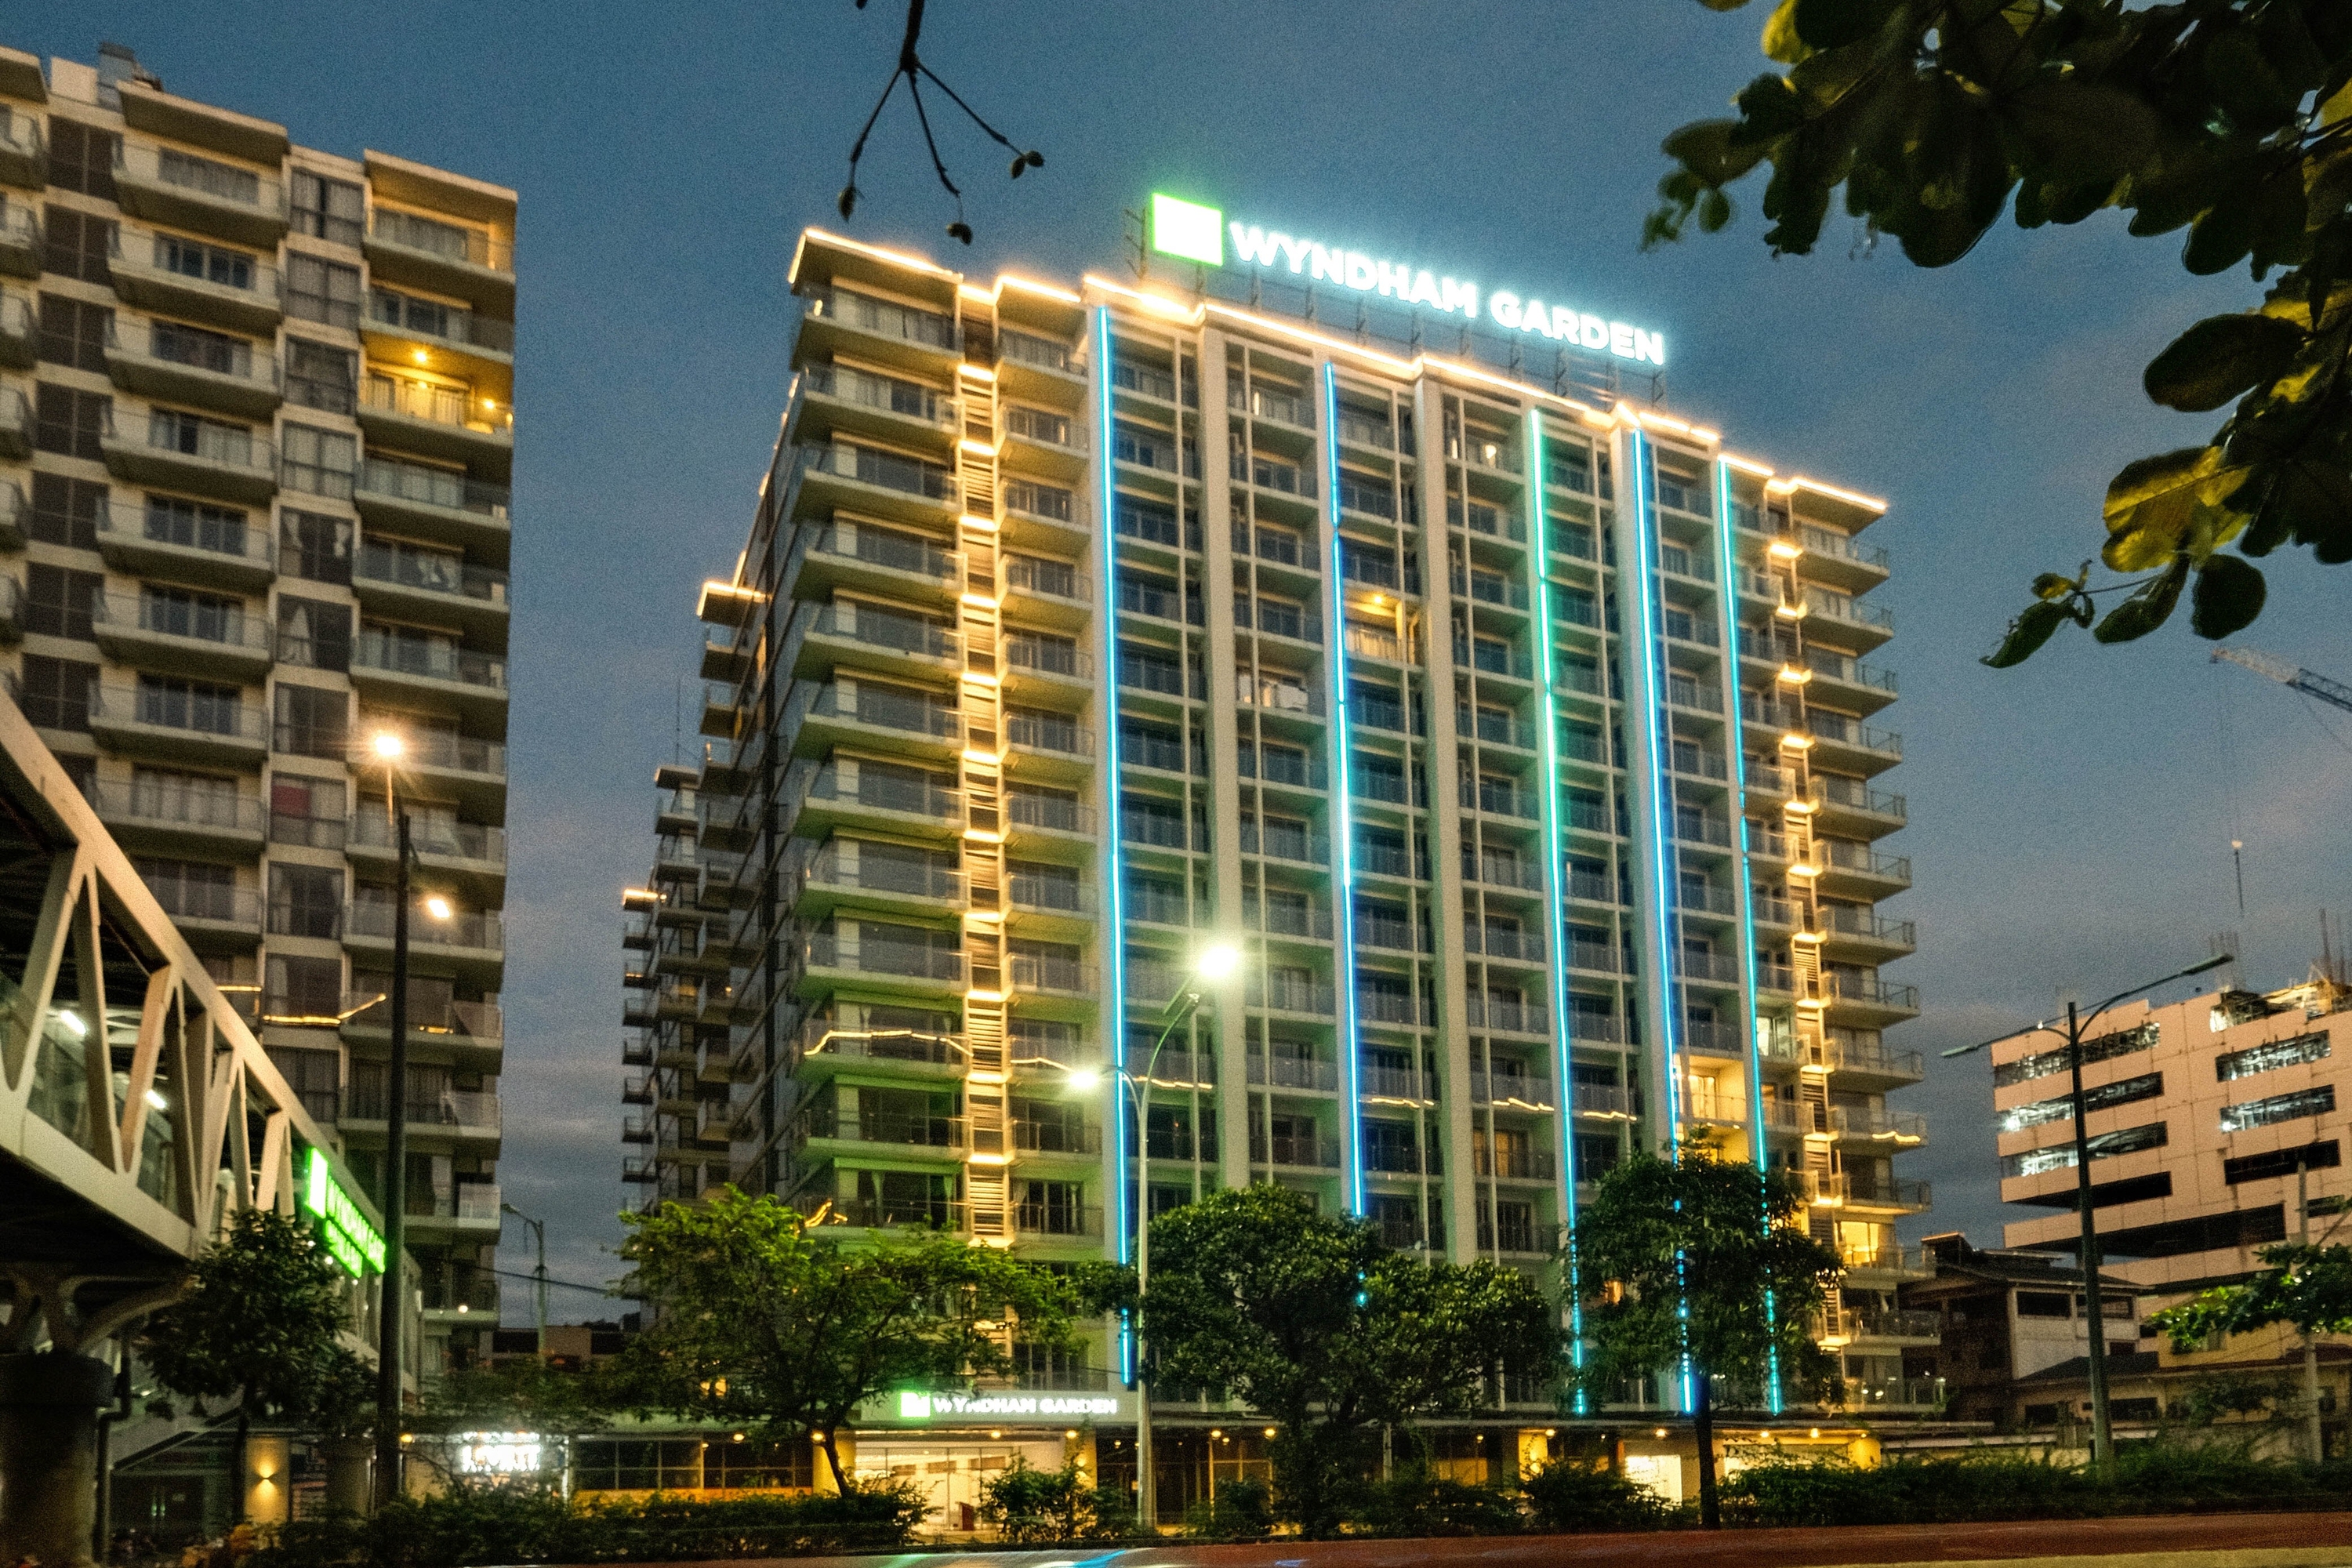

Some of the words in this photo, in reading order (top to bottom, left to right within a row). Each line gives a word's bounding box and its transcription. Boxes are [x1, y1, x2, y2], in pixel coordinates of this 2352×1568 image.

[1229, 223, 1477, 318] WYNDHAM
[1490, 291, 1664, 366] GARDEN
[1040, 1398, 1117, 1414] GARDEN
